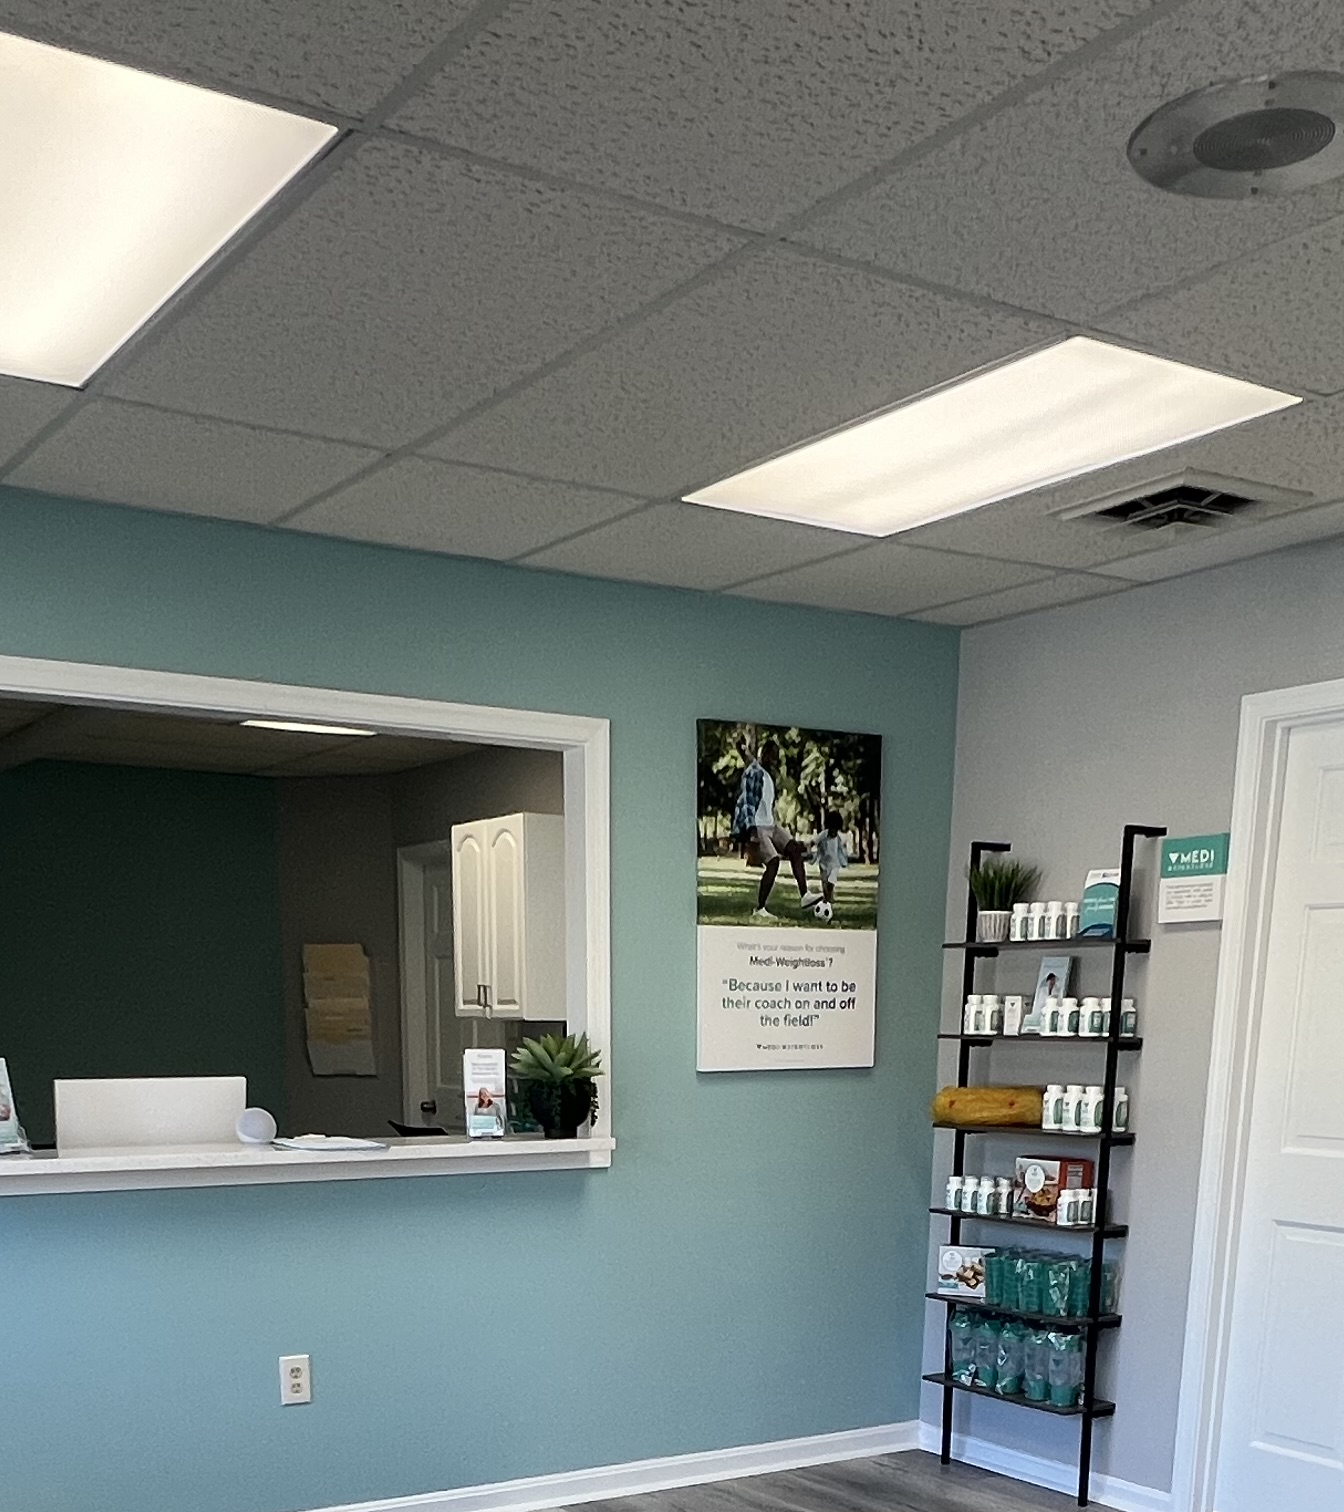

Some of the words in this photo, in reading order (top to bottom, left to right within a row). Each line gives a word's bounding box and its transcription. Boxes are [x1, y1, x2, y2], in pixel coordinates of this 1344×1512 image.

[1180, 849, 1214, 863] MEDI
[793, 981, 823, 992] want
[826, 981, 838, 992] to
[841, 980, 856, 993] be
[722, 996, 751, 1009] their
[755, 997, 791, 1010] coach
[795, 999, 810, 1010] on
[813, 997, 836, 1010] and
[839, 996, 856, 1010] off
[760, 1014, 780, 1027] the
